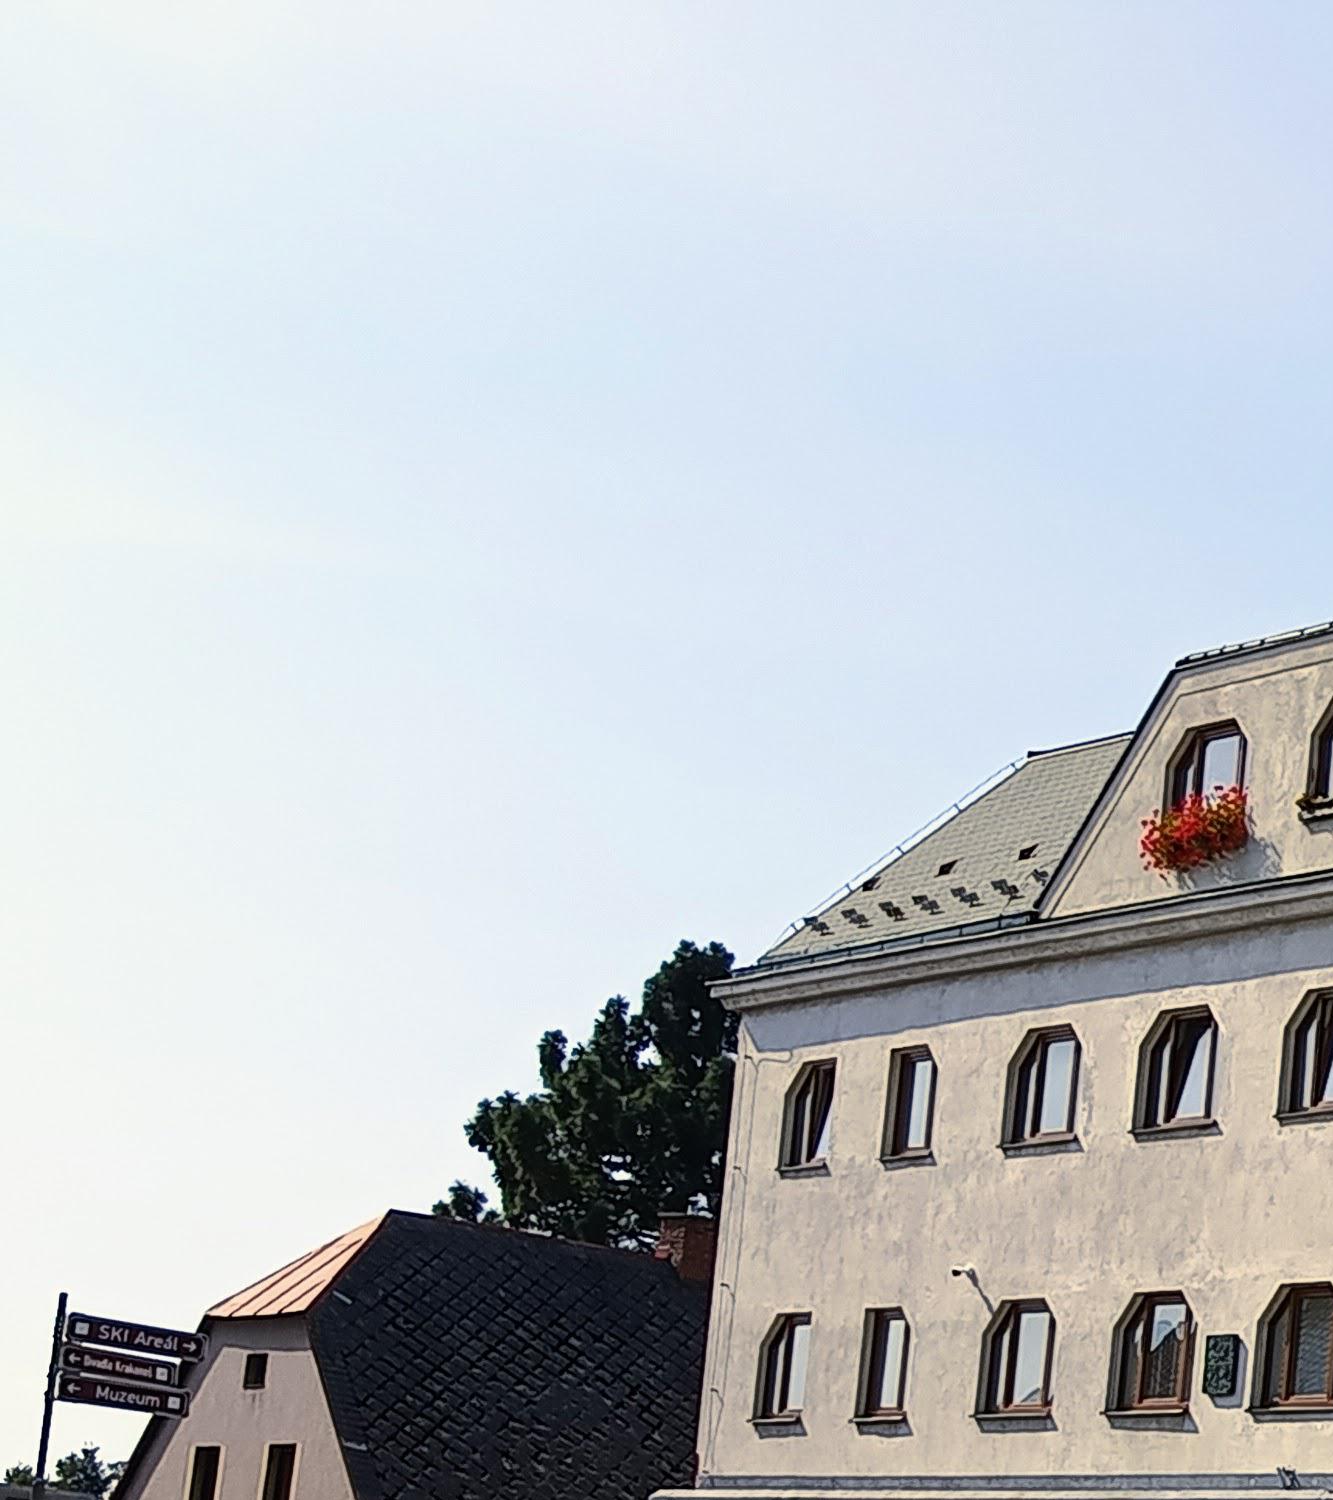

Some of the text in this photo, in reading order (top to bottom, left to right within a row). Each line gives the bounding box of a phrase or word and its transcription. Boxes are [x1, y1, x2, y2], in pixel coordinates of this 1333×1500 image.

[98, 1325, 179, 1351] SKI Areál
[95, 1385, 161, 1408] Muzeum
